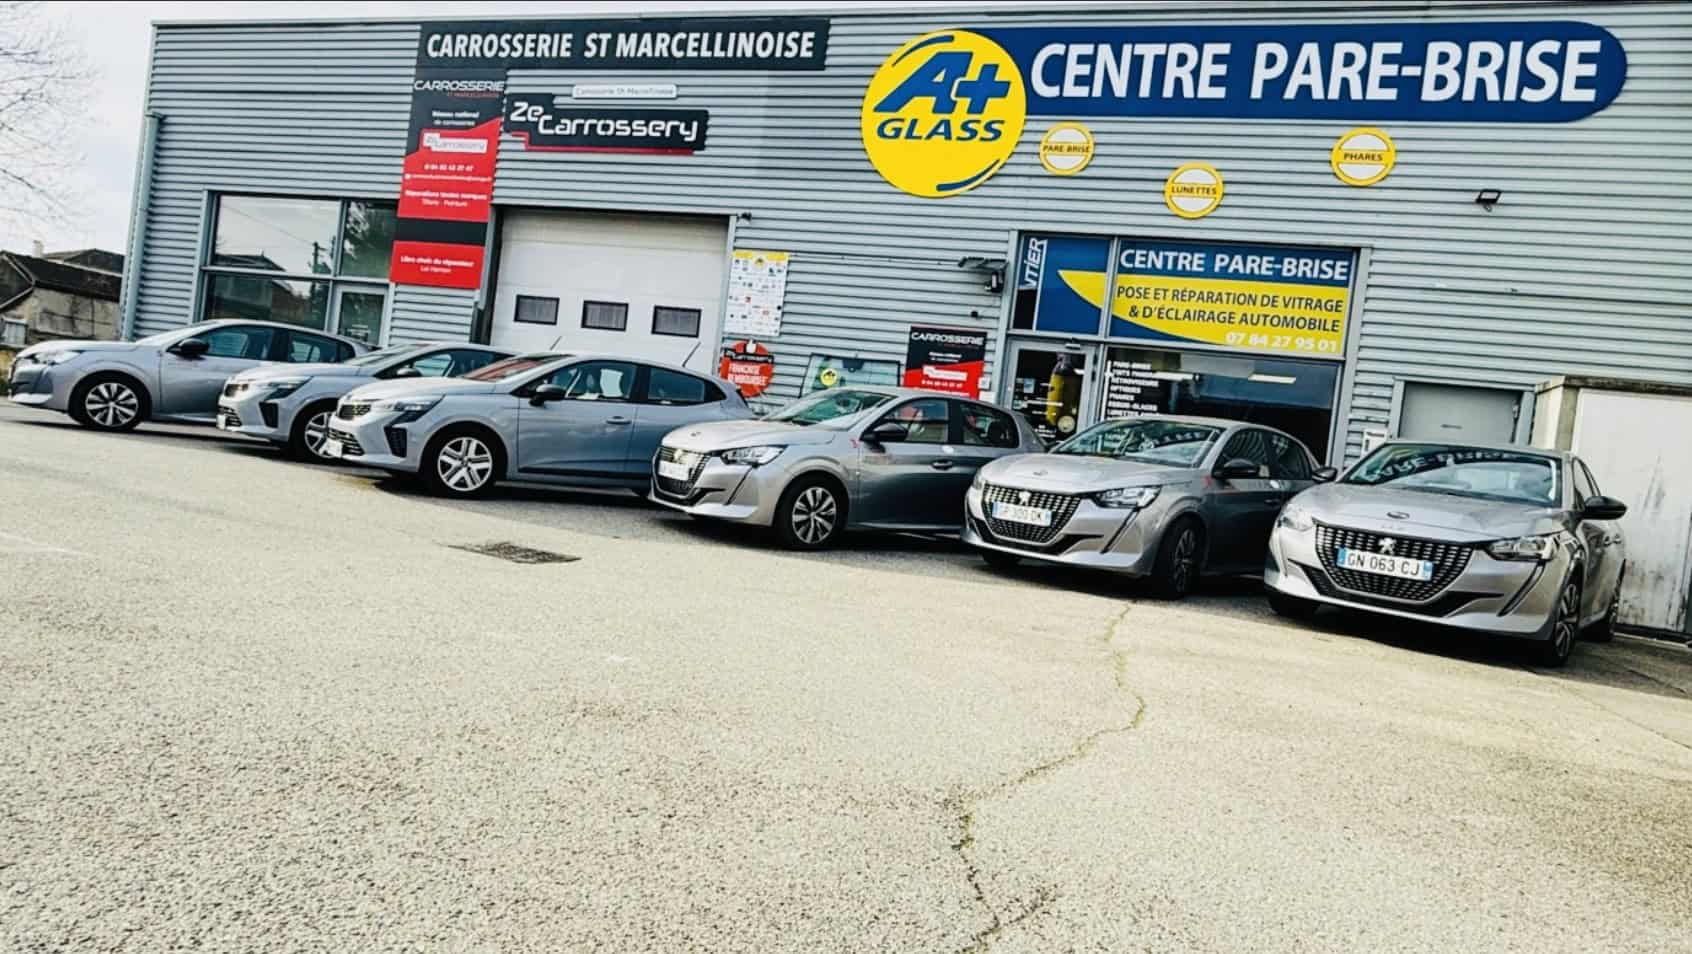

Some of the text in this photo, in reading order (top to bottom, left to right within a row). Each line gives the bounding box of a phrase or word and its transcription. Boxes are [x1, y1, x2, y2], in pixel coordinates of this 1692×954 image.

[427, 31, 815, 58] CARROSSERIE ST MARCELLINOISE
[873, 51, 1011, 114] A+
[1031, 39, 1601, 102] CENTRE PARE-BRISE
[414, 80, 505, 92] CARROSSERIE
[538, 115, 698, 142] Carrossery
[877, 118, 1005, 141] GLASS
[1343, 152, 1383, 162] PHARES
[1171, 184, 1217, 196] LUNETTES
[1120, 249, 1349, 282] CENTRE PARE-BRISE
[1117, 286, 1344, 313] POSE ET RÉPARATION DE VITRAGE
[1129, 305, 1138, 318] &
[1239, 312, 1340, 333] AUTOMOBILE
[911, 332, 985, 345] CARROSSERIE
[1225, 332, 1246, 345] 07
[1271, 334, 1292, 348] 27
[1318, 338, 1338, 352] 01
[1347, 552, 1421, 576] GN 063 CJ
